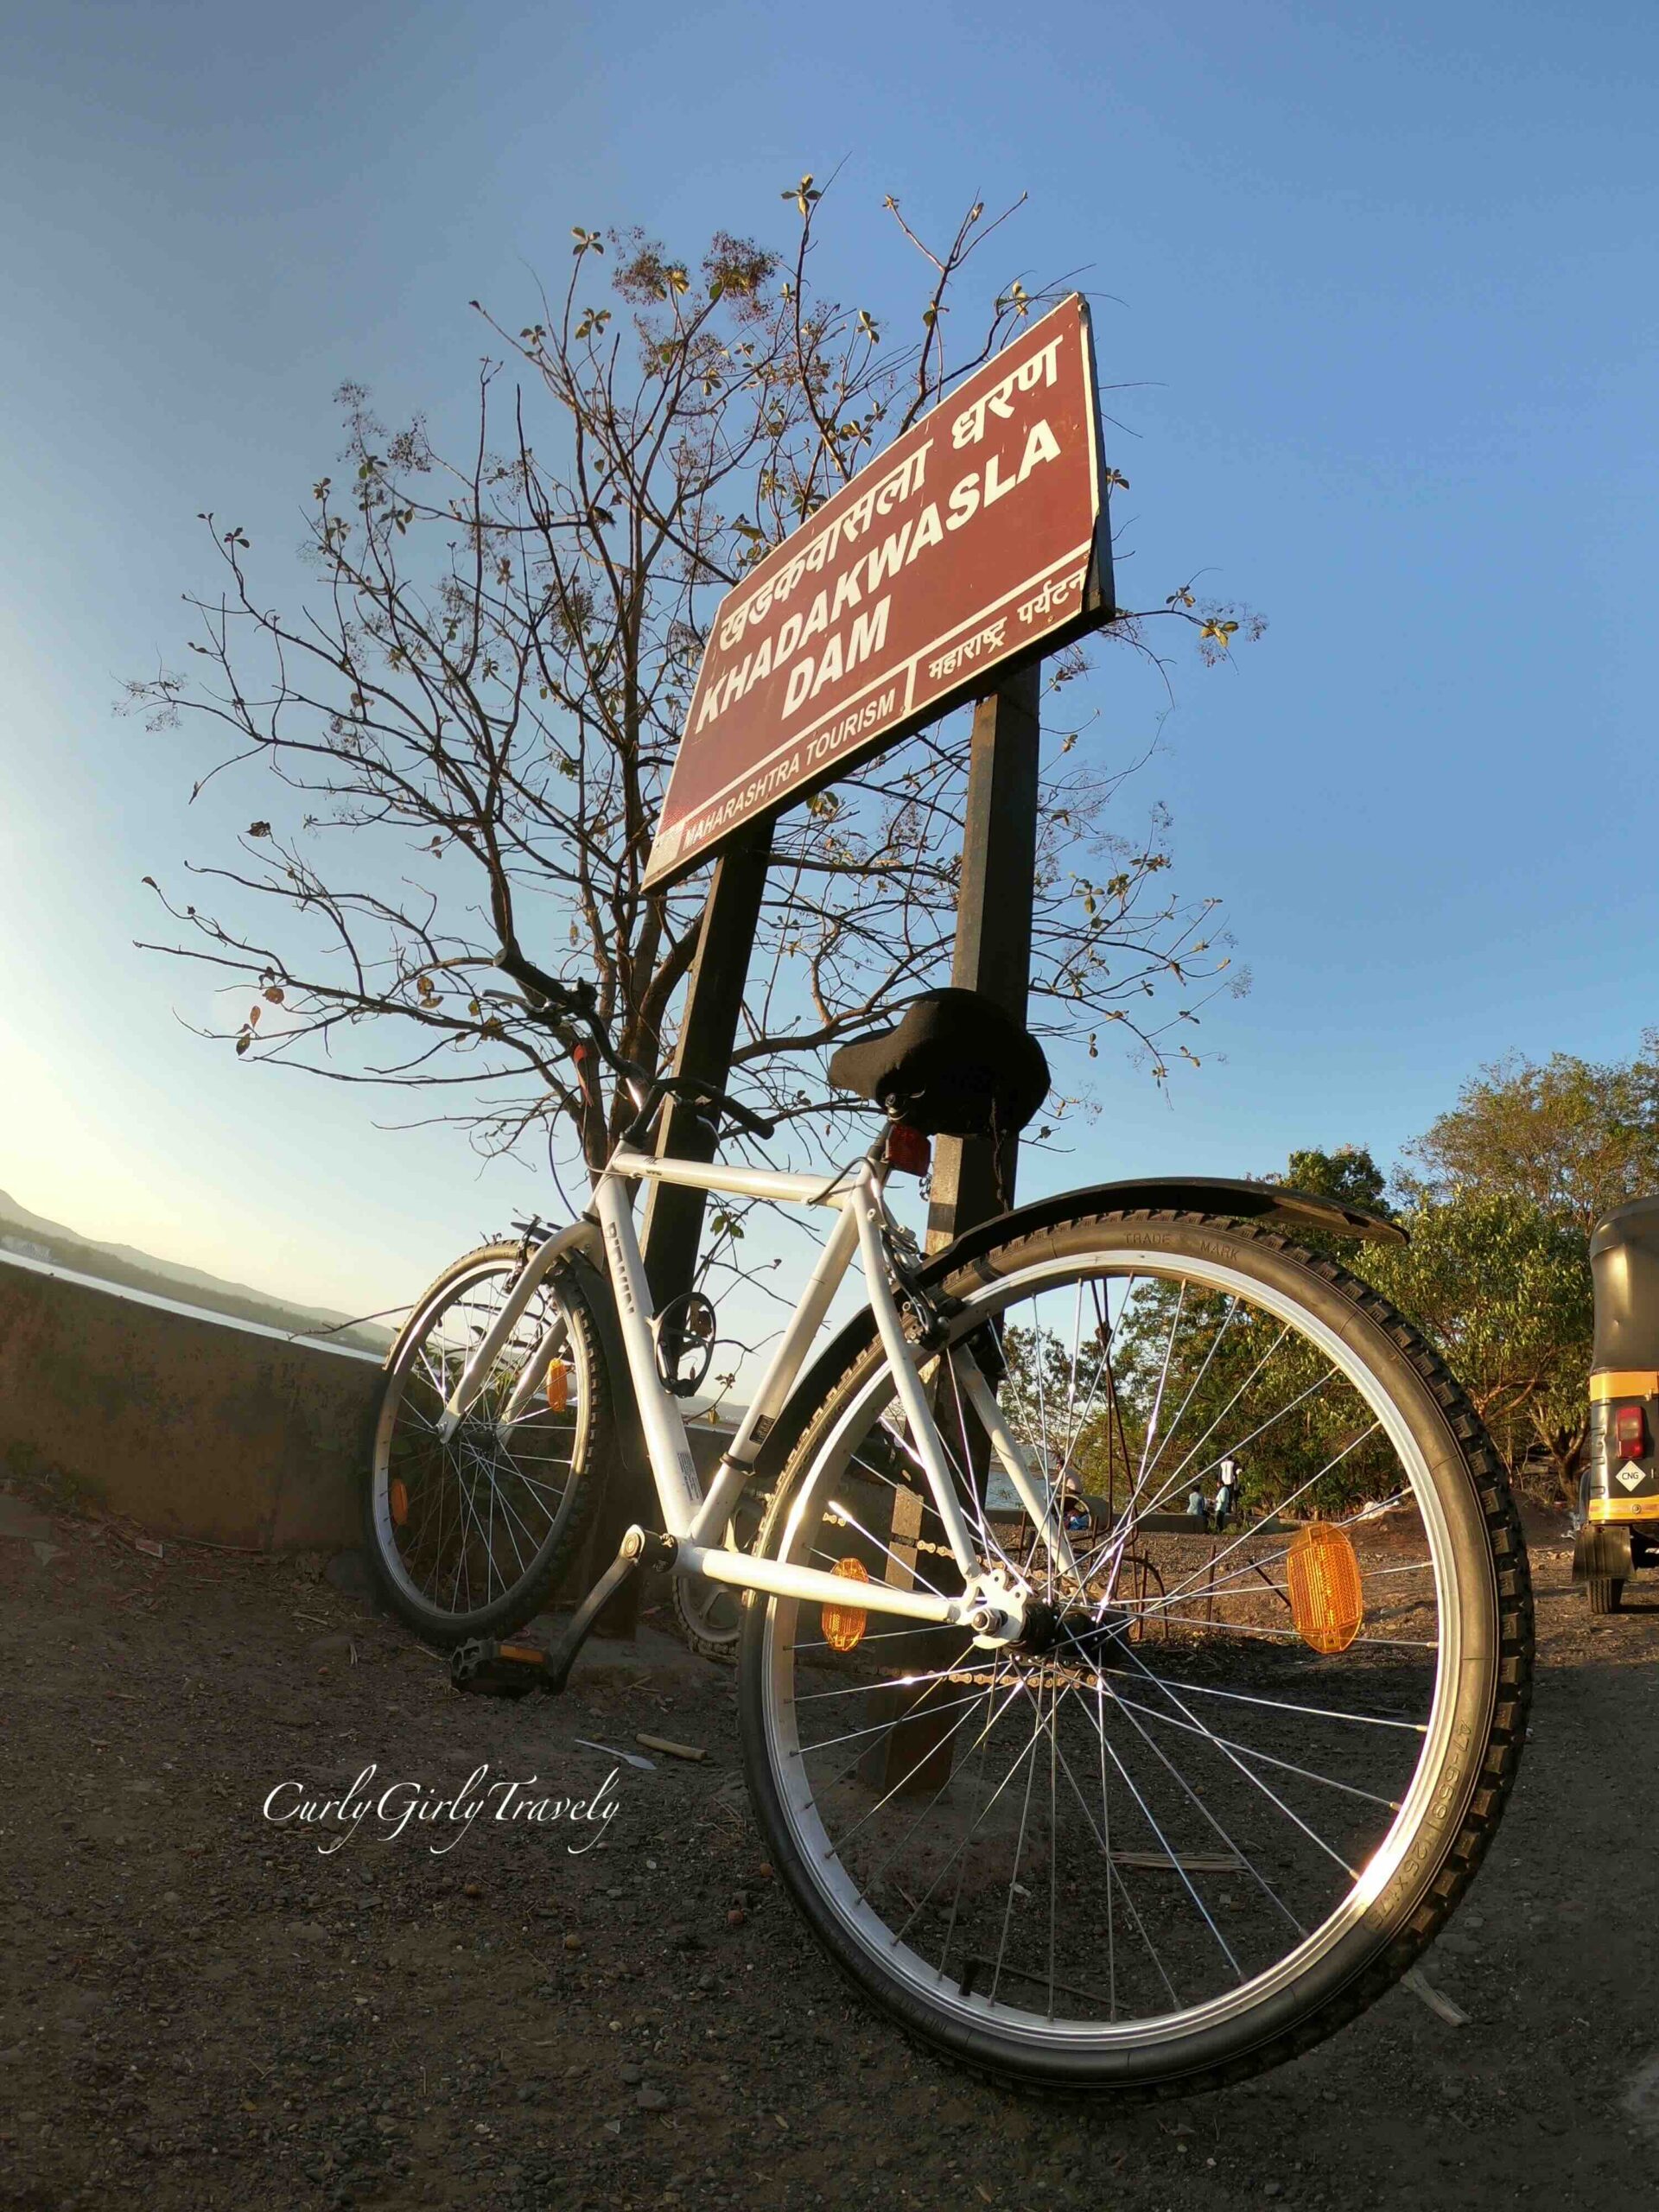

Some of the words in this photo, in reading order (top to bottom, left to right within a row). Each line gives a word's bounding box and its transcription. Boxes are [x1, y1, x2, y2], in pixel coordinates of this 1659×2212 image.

[719, 438, 934, 651] खडकवासला
[951, 334, 1064, 450] धरण
[695, 418, 1062, 734] KHADAKWASLA
[928, 616, 1008, 680] महाराष्ट्र
[1016, 564, 1089, 625] पर्यटन
[781, 594, 892, 721] DAM
[682, 752, 801, 851] MAHARASHTRA
[805, 687, 896, 766] TOURISM
[1125, 1232, 1171, 1245] TRADE
[1199, 1239, 1240, 1262] MARK
[1621, 1471, 1639, 1480] CNG
